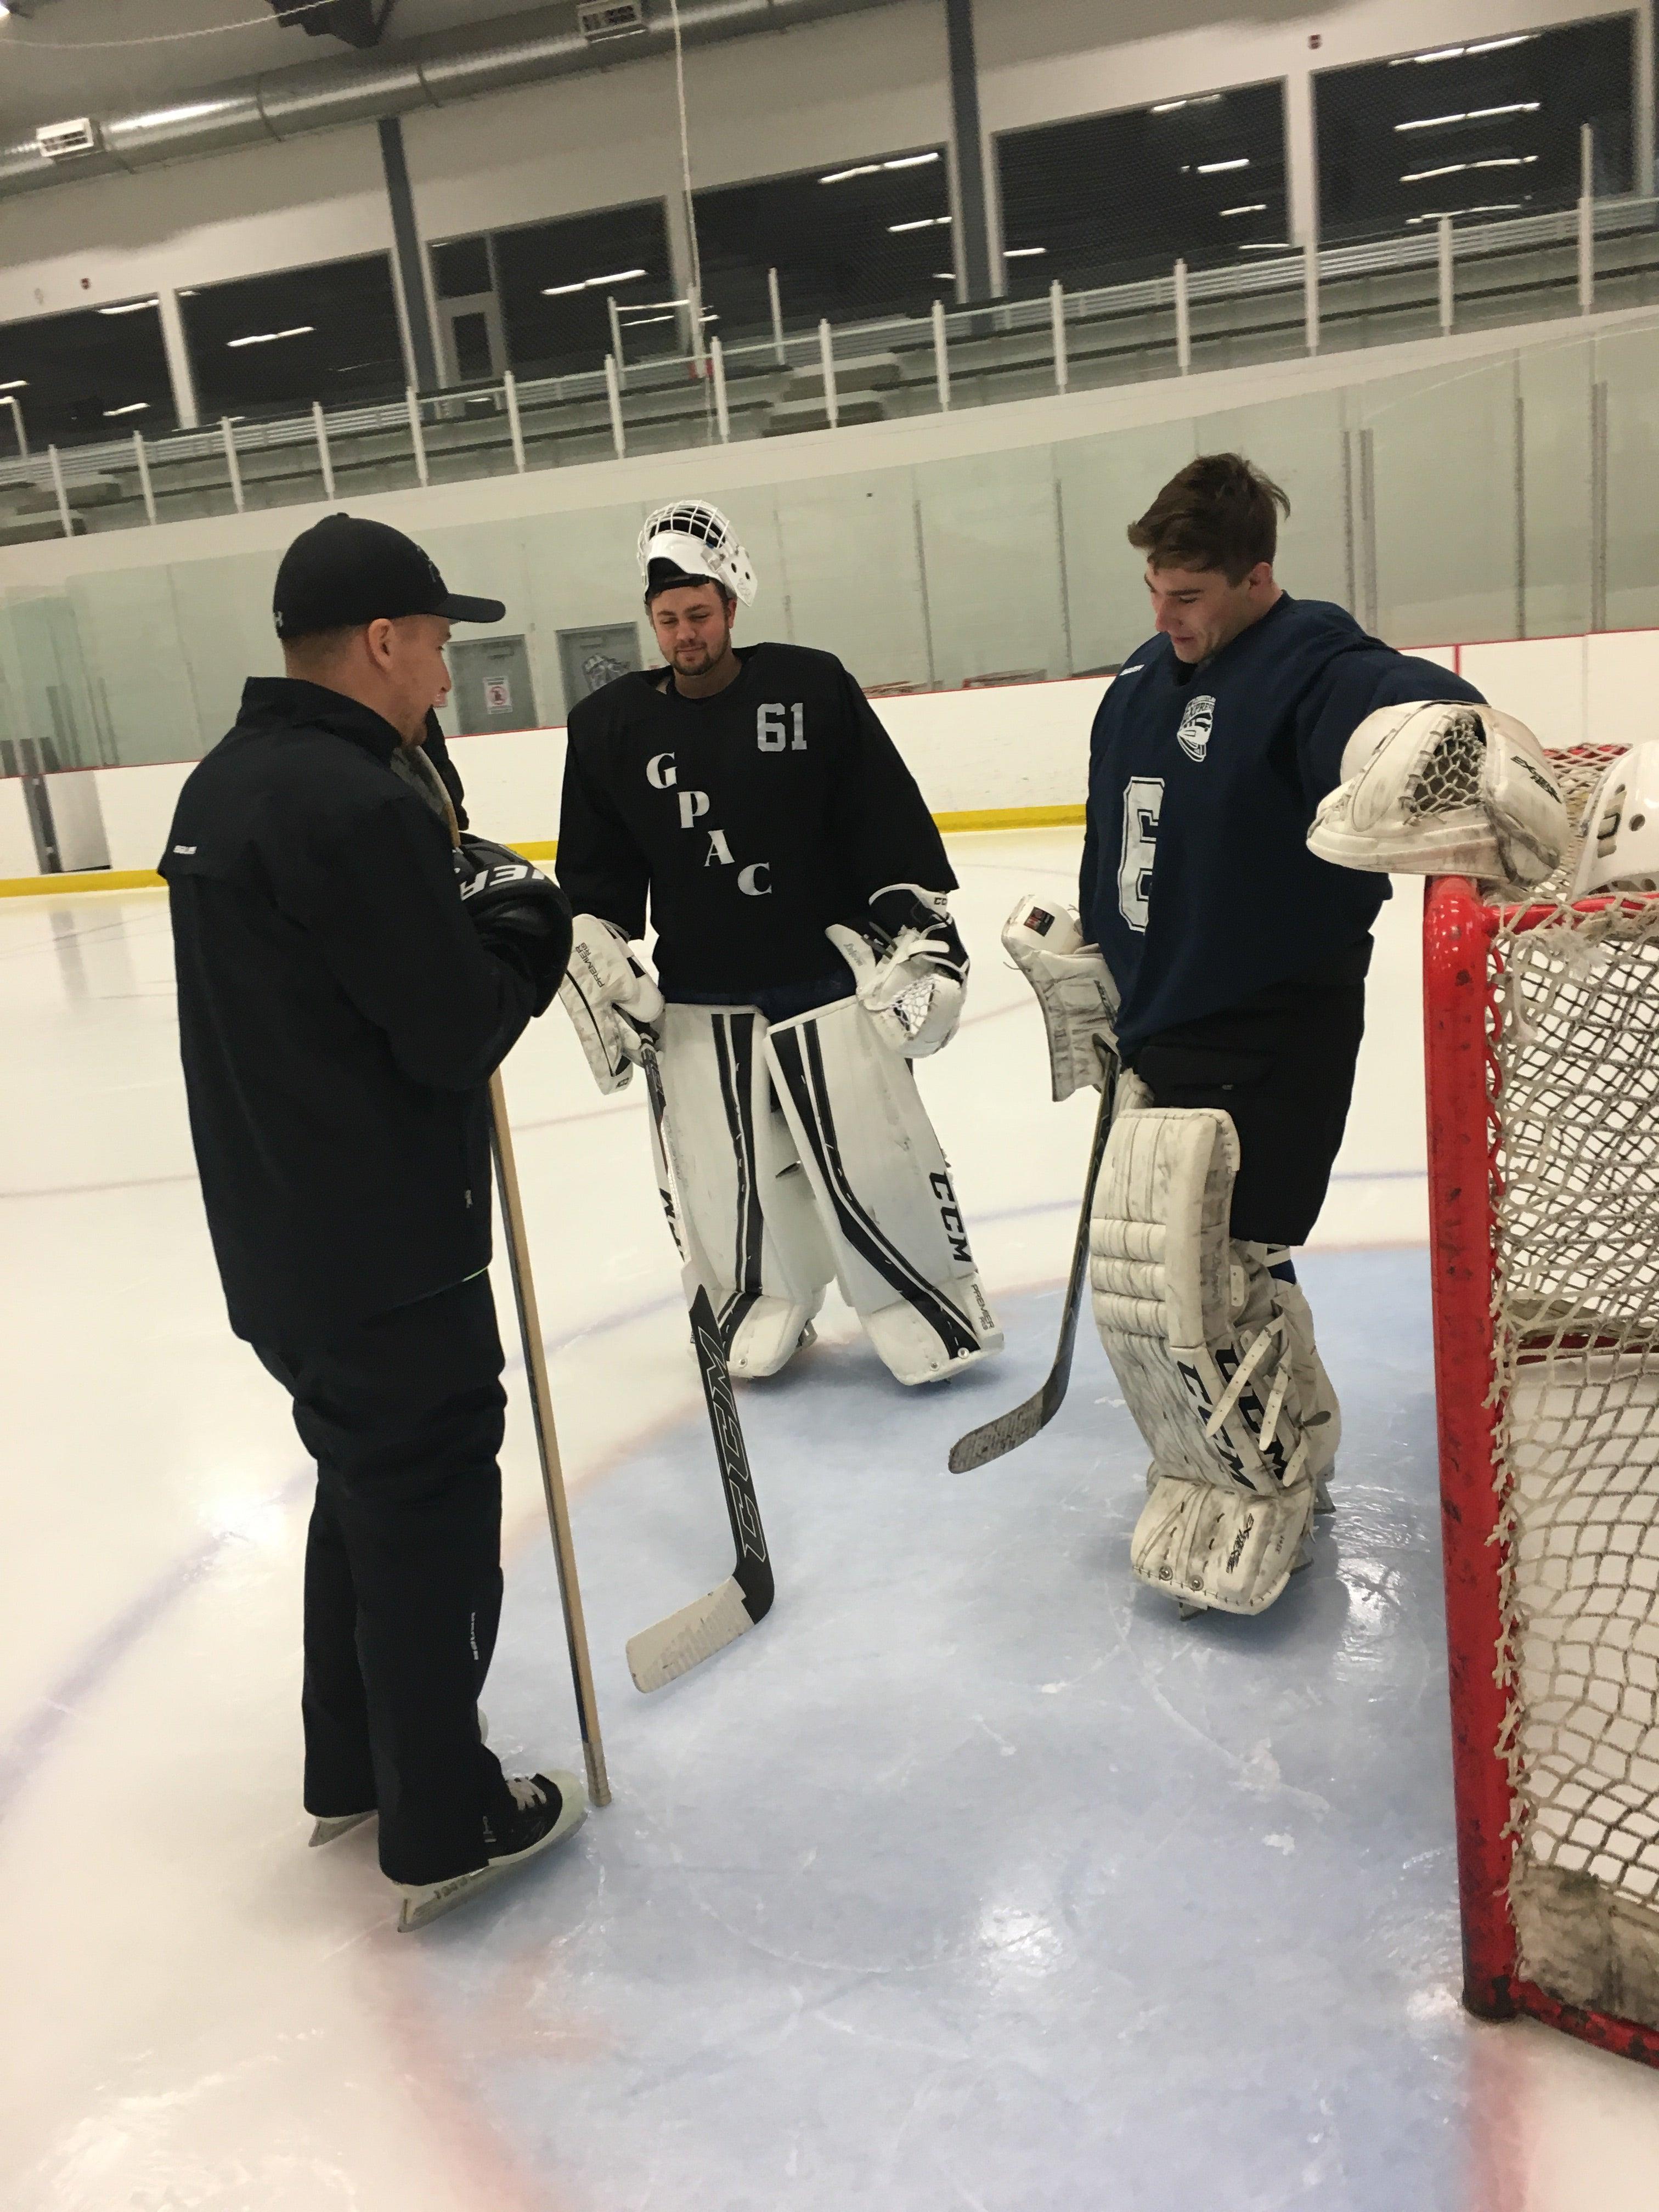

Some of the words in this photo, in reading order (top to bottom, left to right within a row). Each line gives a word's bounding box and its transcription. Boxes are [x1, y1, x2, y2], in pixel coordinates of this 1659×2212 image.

[757, 702, 807, 752] 61
[575, 945, 605, 988] PREMIER
[929, 1171, 973, 1262] CCM
[970, 1284, 995, 1329] PREMIER
[698, 1325, 766, 1563] CCM
